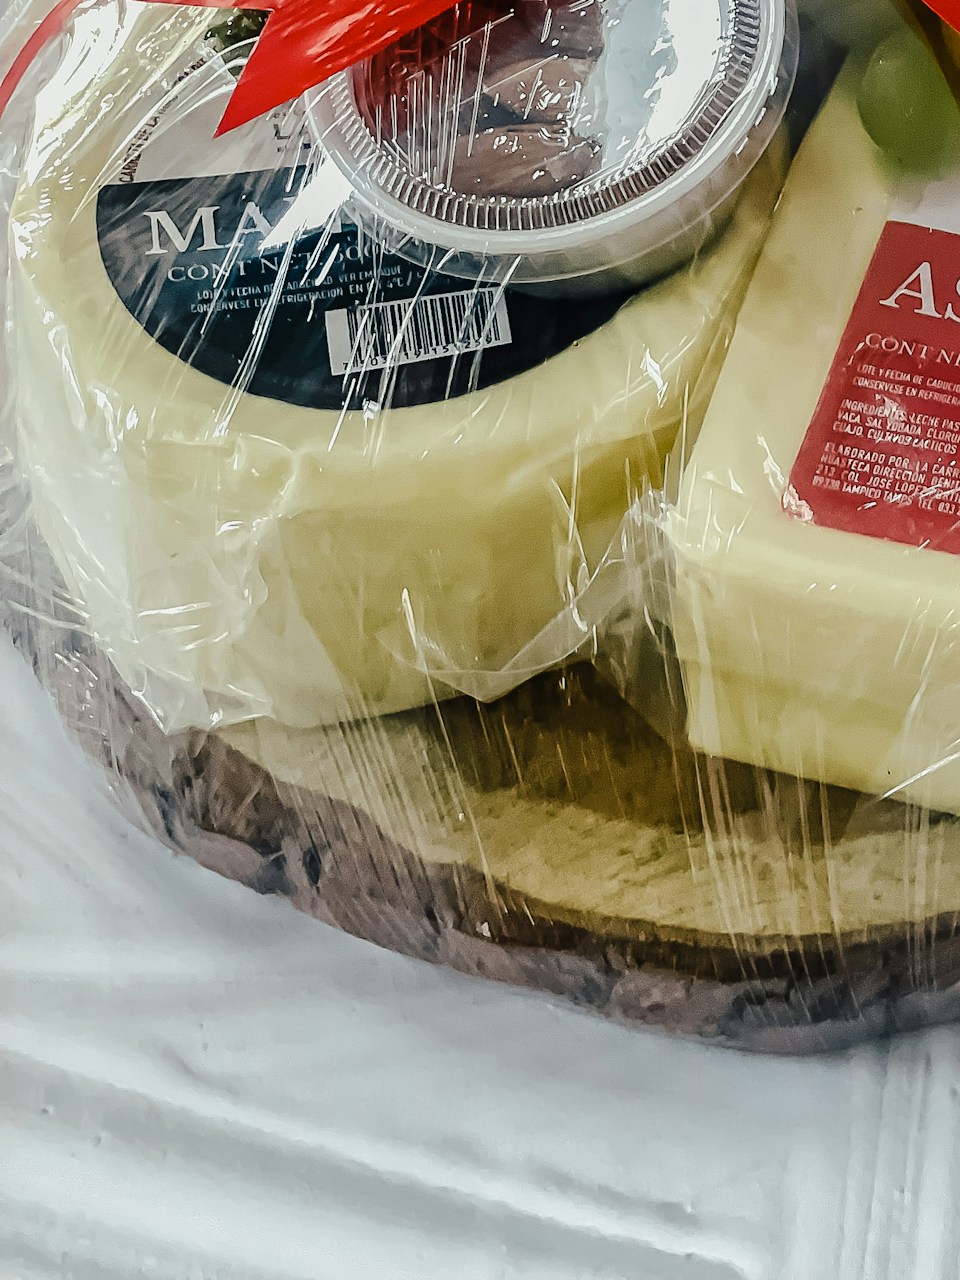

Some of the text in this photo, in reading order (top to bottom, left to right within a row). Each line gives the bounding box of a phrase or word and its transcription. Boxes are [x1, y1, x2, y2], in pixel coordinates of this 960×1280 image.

[885, 369, 911, 381] FECHA
[912, 374, 923, 384] DE
[905, 386, 916, 396] EN
